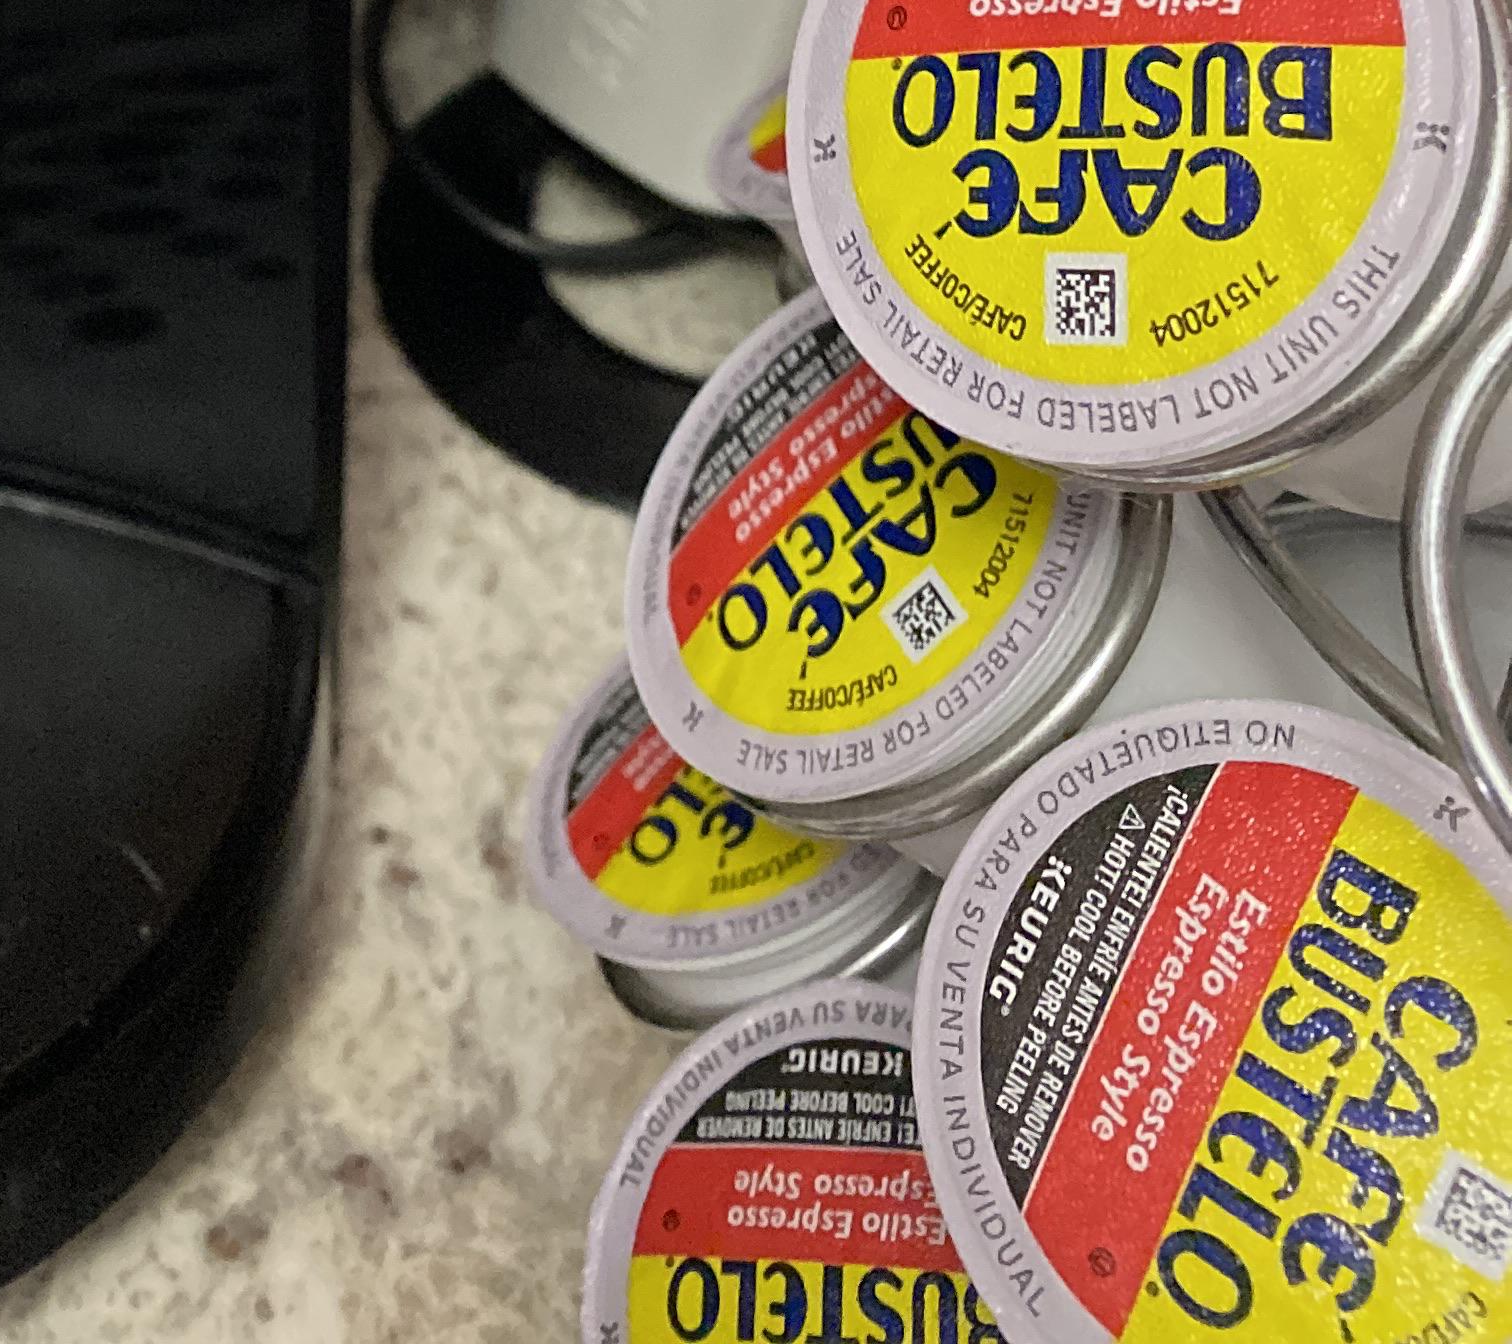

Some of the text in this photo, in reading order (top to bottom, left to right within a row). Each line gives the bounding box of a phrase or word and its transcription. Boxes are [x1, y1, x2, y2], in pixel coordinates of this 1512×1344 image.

[837, 230, 884, 303] SALE
[1335, 245, 1403, 312] THIS
[1149, 260, 1279, 348] 71512004
[886, 297, 963, 388] RETAIL
[1272, 313, 1338, 382] UNIT
[840, 385, 893, 439] stilo
[968, 372, 1025, 418] FOR
[1039, 394, 1179, 434] LABELED
[1193, 370, 1259, 421] NOT
[729, 375, 876, 519] spresso Style
[735, 436, 838, 542] Espresso
[717, 412, 961, 652] USTELO
[973, 491, 1032, 598] 71512004
[1026, 559, 1067, 619] NOT
[935, 618, 1032, 721] LABELED
[738, 738, 788, 774] SALE
[800, 738, 874, 775] RETAIL
[884, 712, 931, 752] FOR
[989, 855, 1073, 1016] KEURIG
[996, 832, 1136, 1114] HOT! COOL BEFORE PEELING
[724, 1006, 805, 1056] VENTA
[812, 999, 845, 1025] SU
[939, 719, 1296, 1318] NO ETIQUETADO PARA SU VENTA INDIVIDUAL
[1061, 972, 1108, 1044] ANTES
[1091, 872, 1229, 1142] Espresso Style
[1126, 888, 1272, 1173] Estilo Espresso
[779, 1048, 903, 1077] KEURIG
[1047, 1040, 1076, 1076] DE
[619, 1052, 722, 1188] INDIVIDUAL
[725, 1089, 786, 1112] PEELING
[765, 1116, 785, 1138] DE
[787, 1116, 835, 1140] ANTES
[789, 1090, 848, 1113] BEFORE
[853, 1091, 894, 1115] COOL
[1008, 1070, 1064, 1171] REMOVER
[734, 1163, 803, 1200] Style
[727, 1204, 949, 1246] Estilo Espresso
